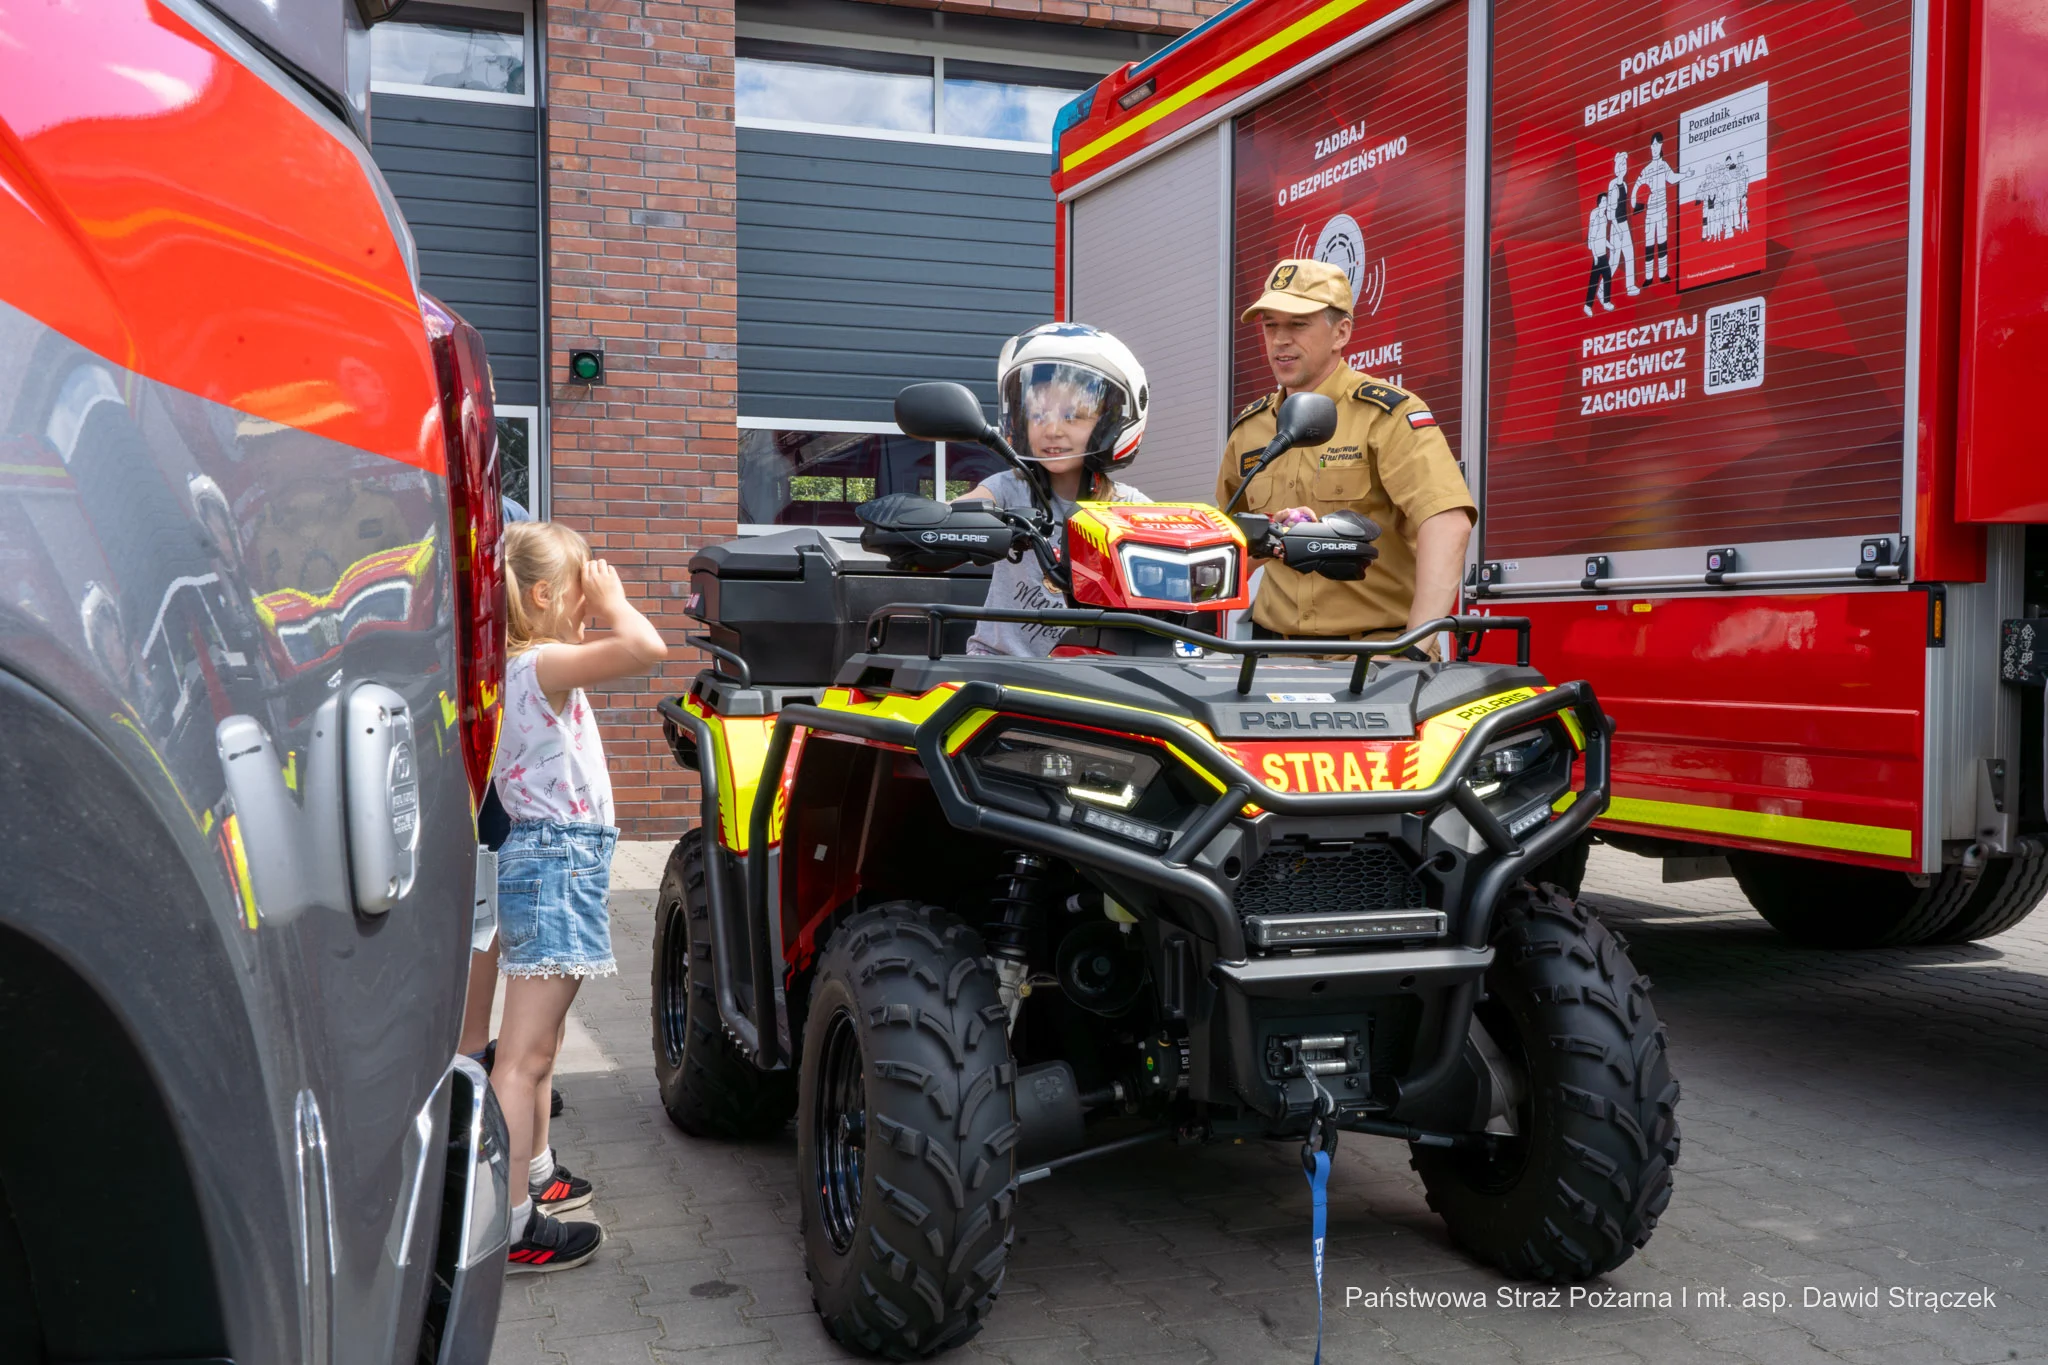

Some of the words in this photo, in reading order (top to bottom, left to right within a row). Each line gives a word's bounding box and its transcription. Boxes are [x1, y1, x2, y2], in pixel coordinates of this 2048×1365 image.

[1620, 16, 1727, 81] PORADNIK
[1584, 35, 1769, 127] BEZPIECZEŃSTWA
[1688, 107, 1730, 131] Poradnik
[1688, 111, 1760, 144] bezpieczeństwa
[1314, 120, 1366, 160] ZADBAJ
[1278, 188, 1287, 207] O
[1290, 136, 1408, 202] BEZPIECZEŃSTWO
[1582, 314, 1698, 358] PRZECZYTAJ
[1581, 347, 1686, 387] PRZEĆWICZ
[1580, 378, 1686, 416] ZACHOWAJ!
[940, 533, 990, 543] POLARIS
[1322, 543, 1357, 551] POLARIS
[1239, 711, 1389, 730] POLARIS
[1456, 692, 1531, 720] POLARIS
